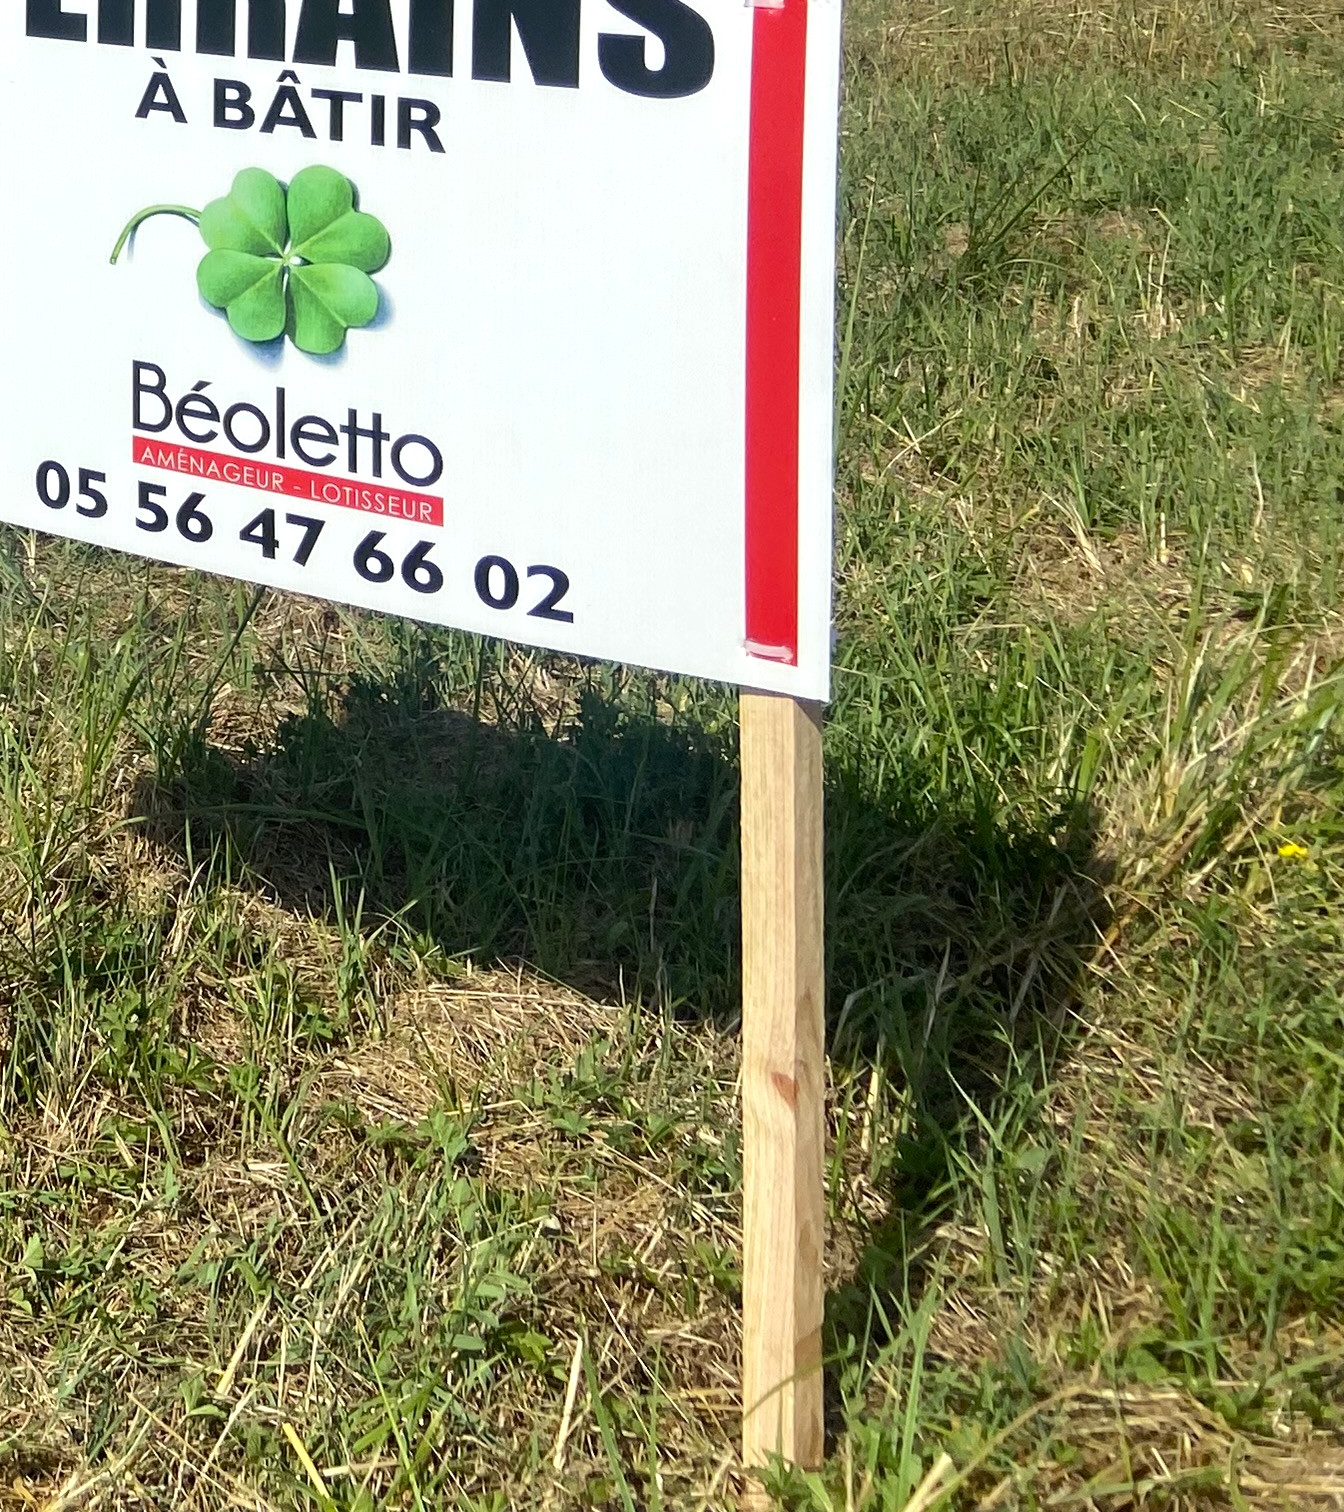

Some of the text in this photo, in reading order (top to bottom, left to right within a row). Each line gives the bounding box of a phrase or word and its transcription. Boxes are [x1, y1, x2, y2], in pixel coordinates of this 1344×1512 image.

[134, 56, 446, 154] À BÂTIR
[132, 359, 444, 487] Béoletto
[140, 446, 285, 492] AMÉNAGEUR
[310, 478, 434, 522] LOTISSEUR
[35, 460, 574, 624] 05 56 47 66 02
